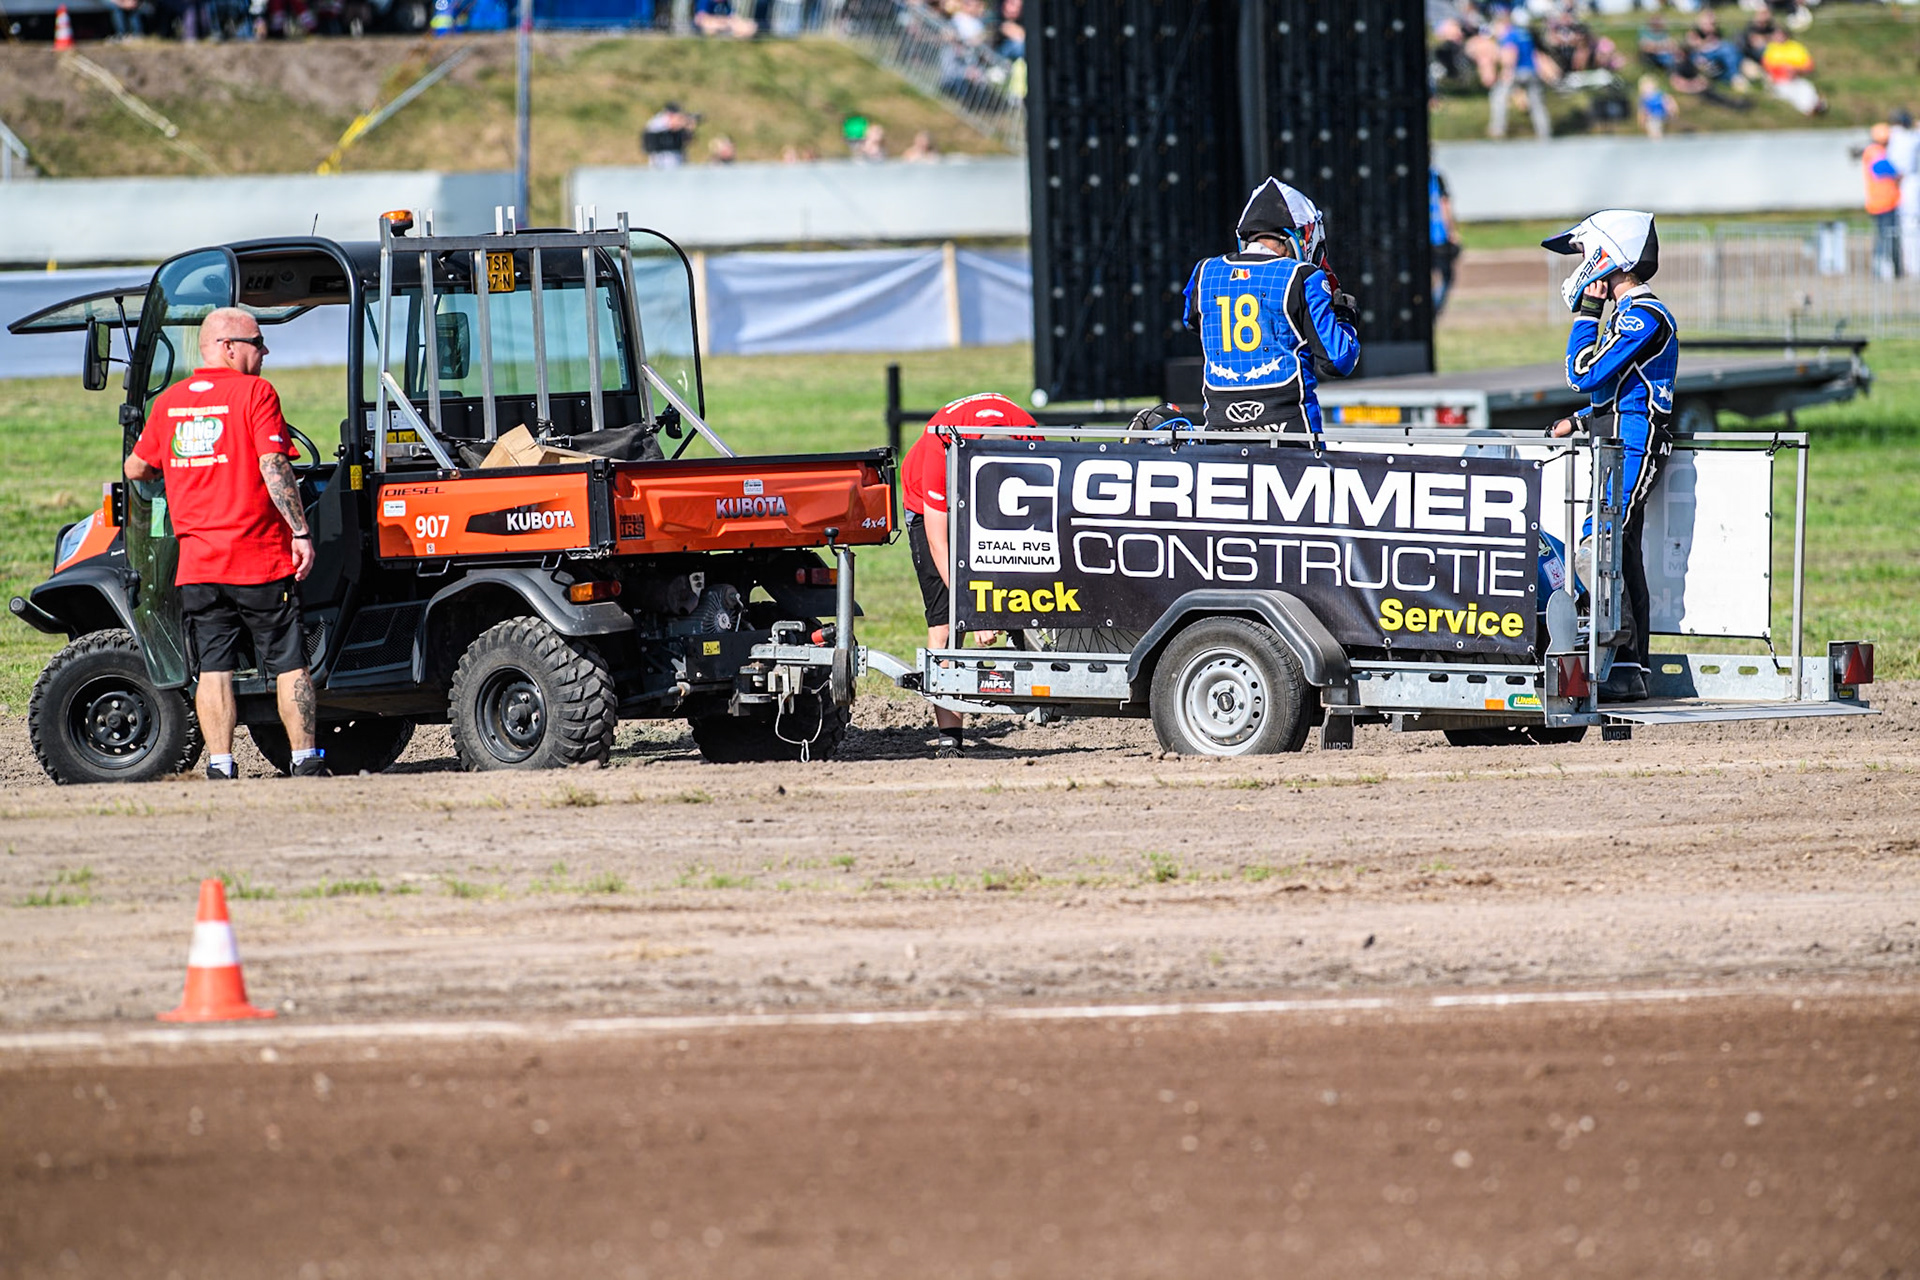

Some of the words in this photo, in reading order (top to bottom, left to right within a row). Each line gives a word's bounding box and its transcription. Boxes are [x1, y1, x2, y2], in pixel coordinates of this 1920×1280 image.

[1216, 293, 1262, 353] 18
[385, 486, 445, 497] DIESEL
[1072, 459, 1528, 534] GREMMER
[716, 496, 789, 519] KUBOTA
[415, 515, 450, 539] 907
[506, 510, 575, 532] KUBOTA
[861, 516, 887, 529] 4x4
[978, 541, 1016, 551] STAAL
[1023, 541, 1051, 552] RVS
[975, 555, 1055, 566] ALUMINIUM
[1072, 531, 1526, 598] CONSTRUCTIE
[969, 580, 1082, 613] Track
[1378, 598, 1524, 638] Service
[980, 680, 1012, 689] IMPEX
